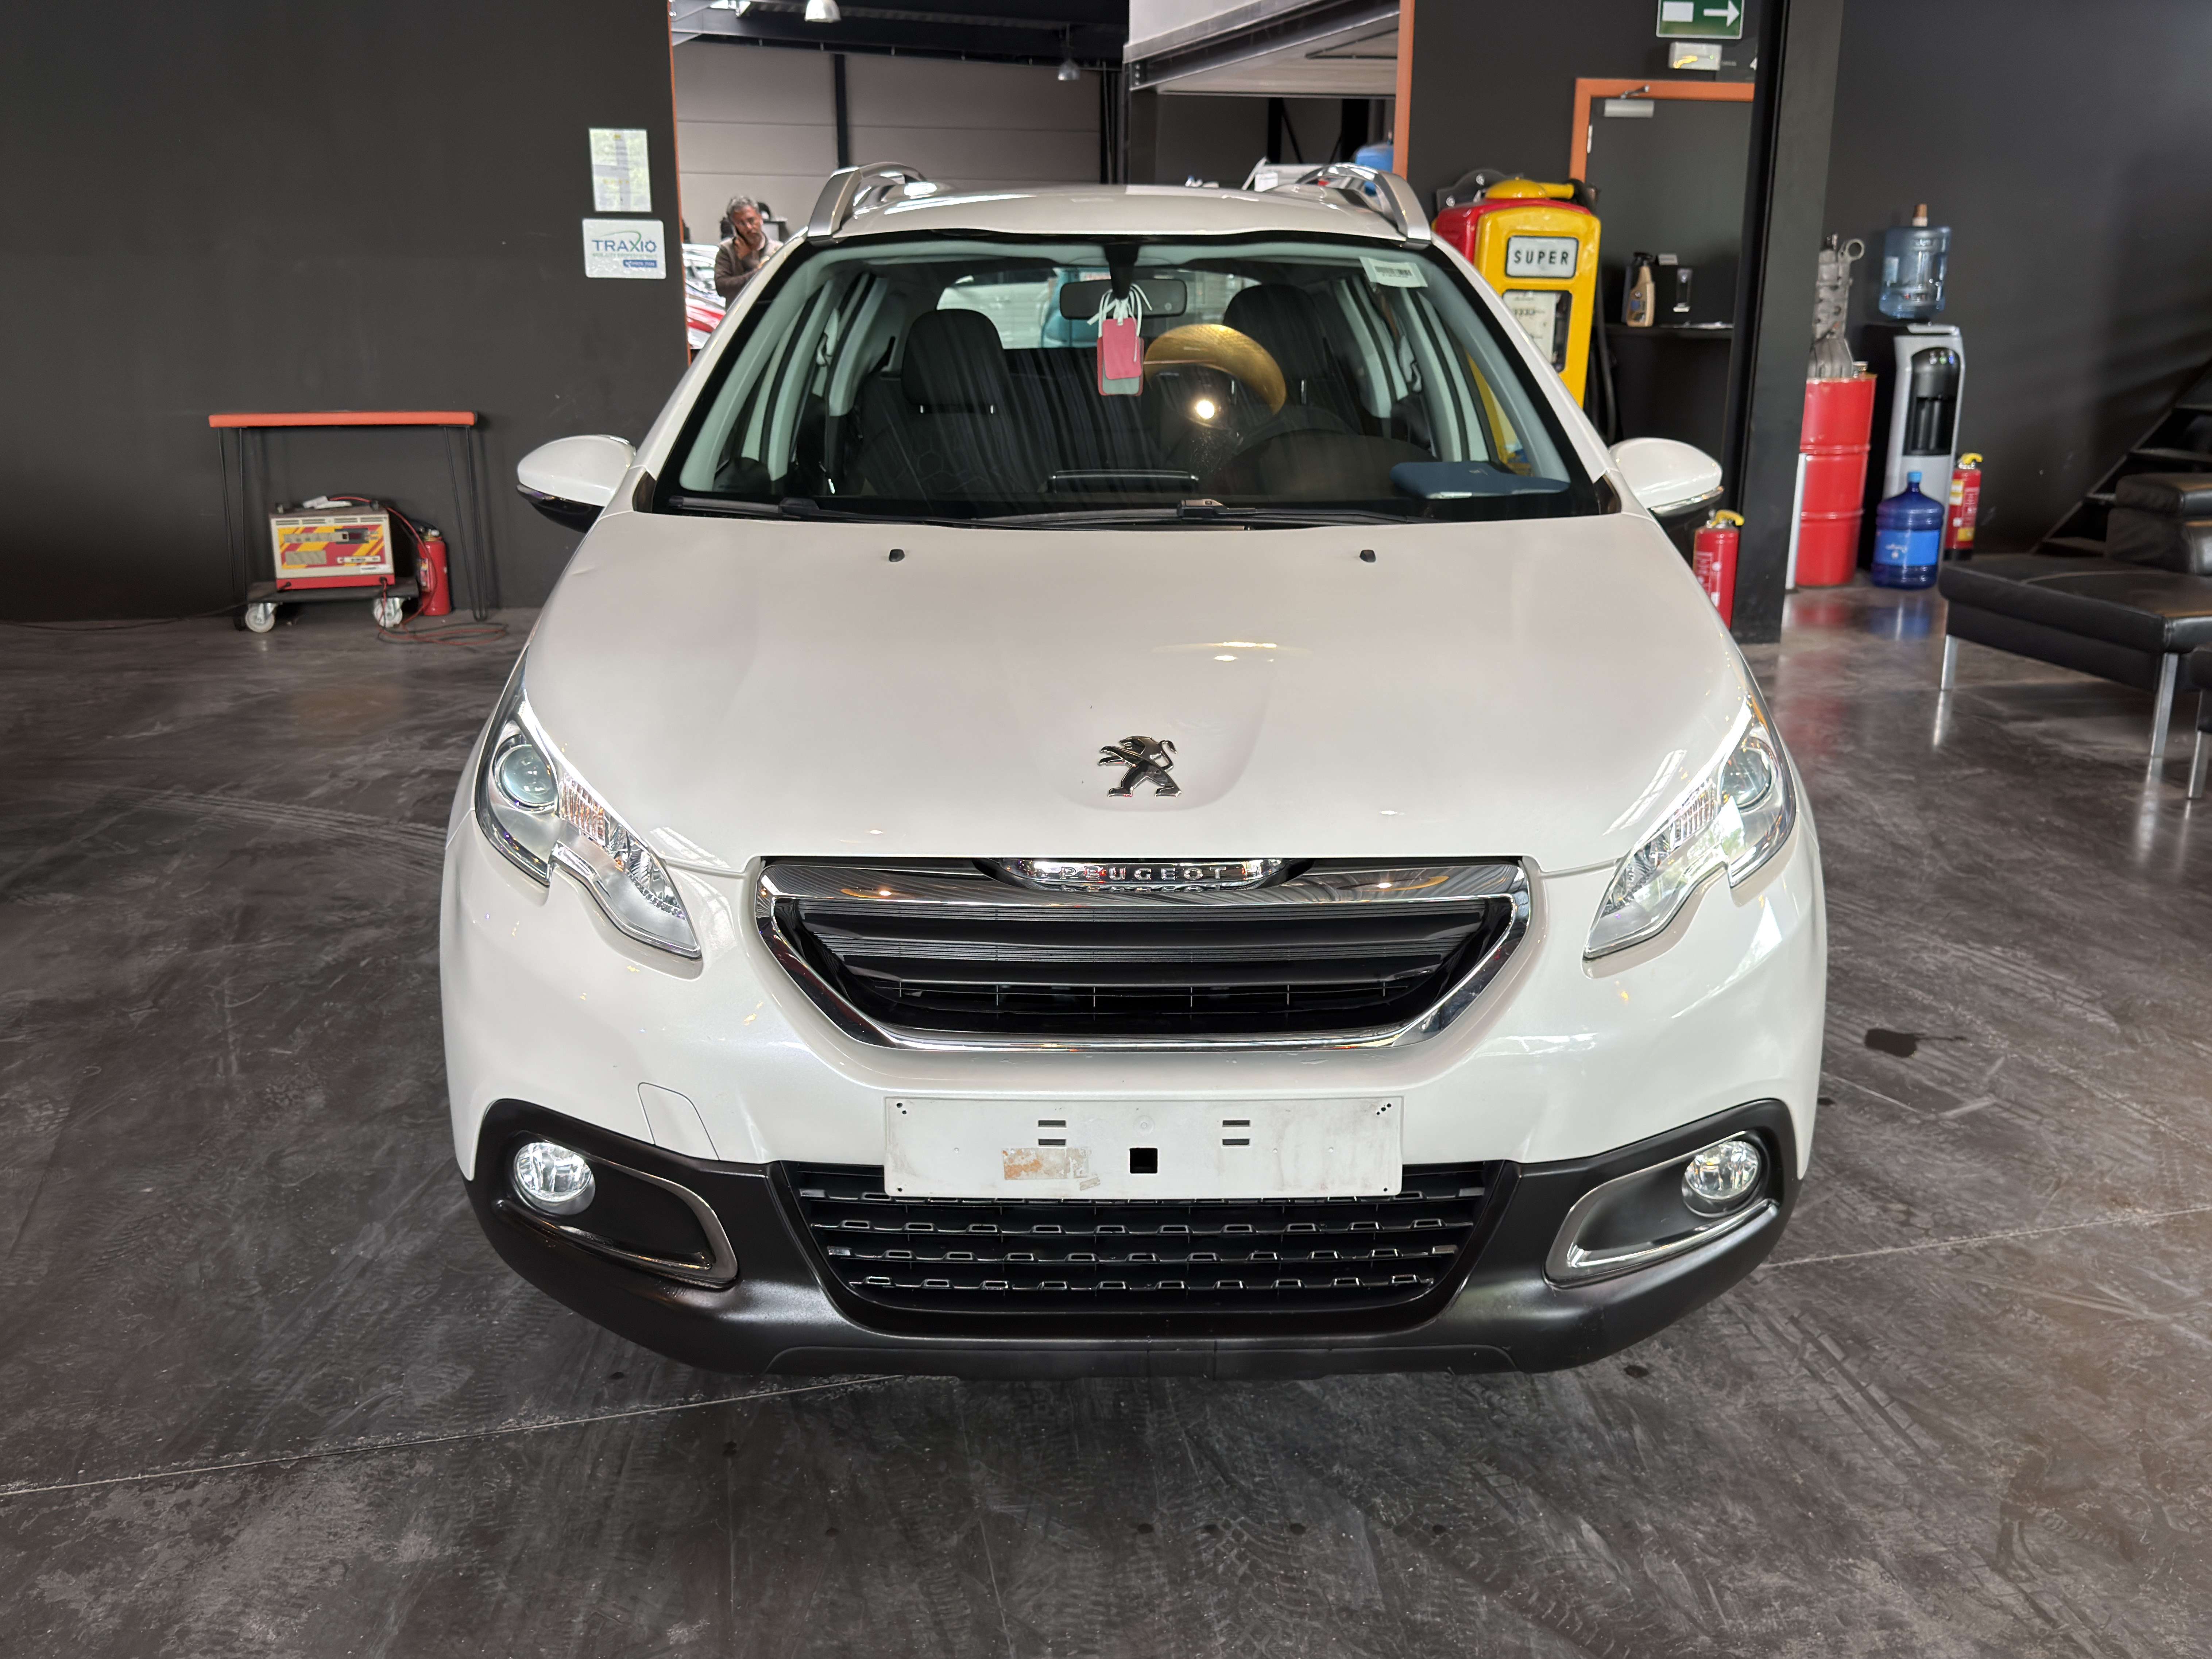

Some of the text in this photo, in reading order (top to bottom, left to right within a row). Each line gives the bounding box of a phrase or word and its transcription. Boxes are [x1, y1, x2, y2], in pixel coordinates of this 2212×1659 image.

[592, 239, 657, 253] TRAXIO
[1514, 250, 1569, 264] SUPER
[1059, 866, 1227, 881] PEUGEOT
